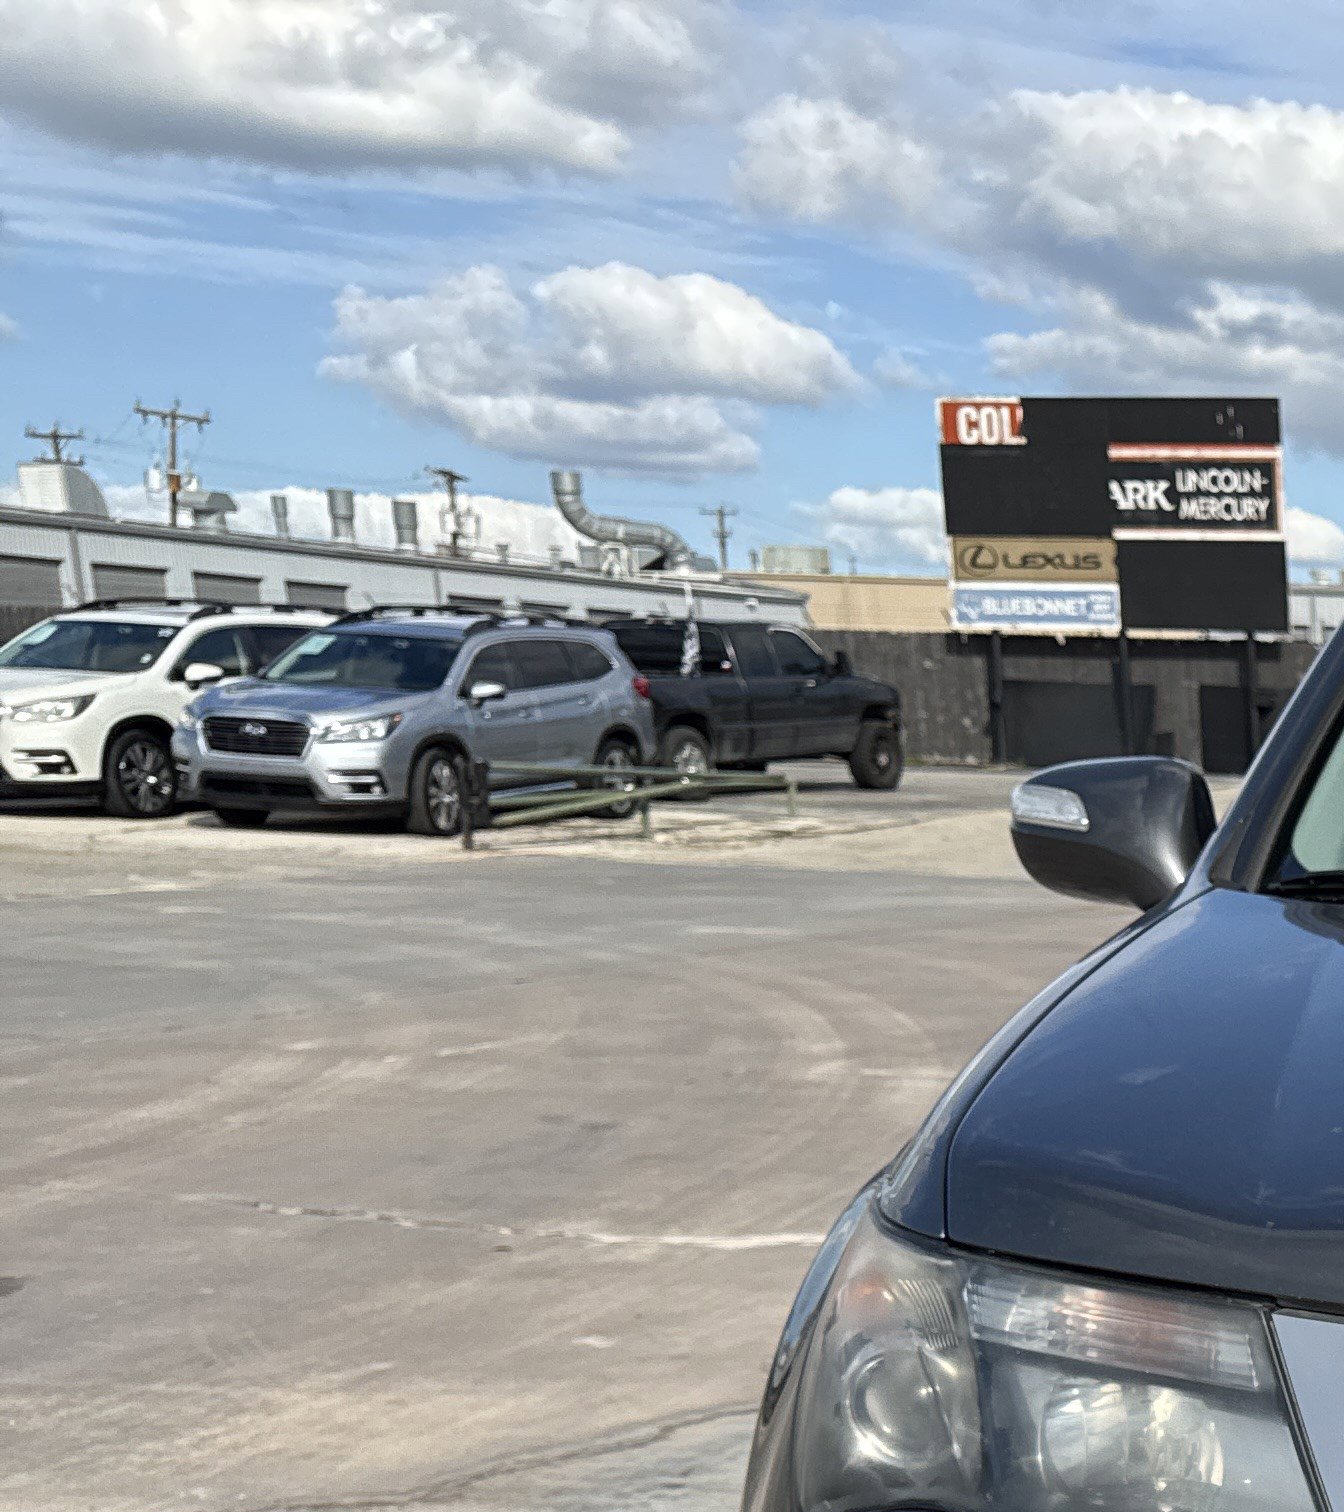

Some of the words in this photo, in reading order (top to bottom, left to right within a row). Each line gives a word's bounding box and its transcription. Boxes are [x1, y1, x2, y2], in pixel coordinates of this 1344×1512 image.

[956, 405, 1028, 445] COL
[1177, 496, 1270, 521] MERCURY
[1002, 552, 1102, 570] LEXUS
